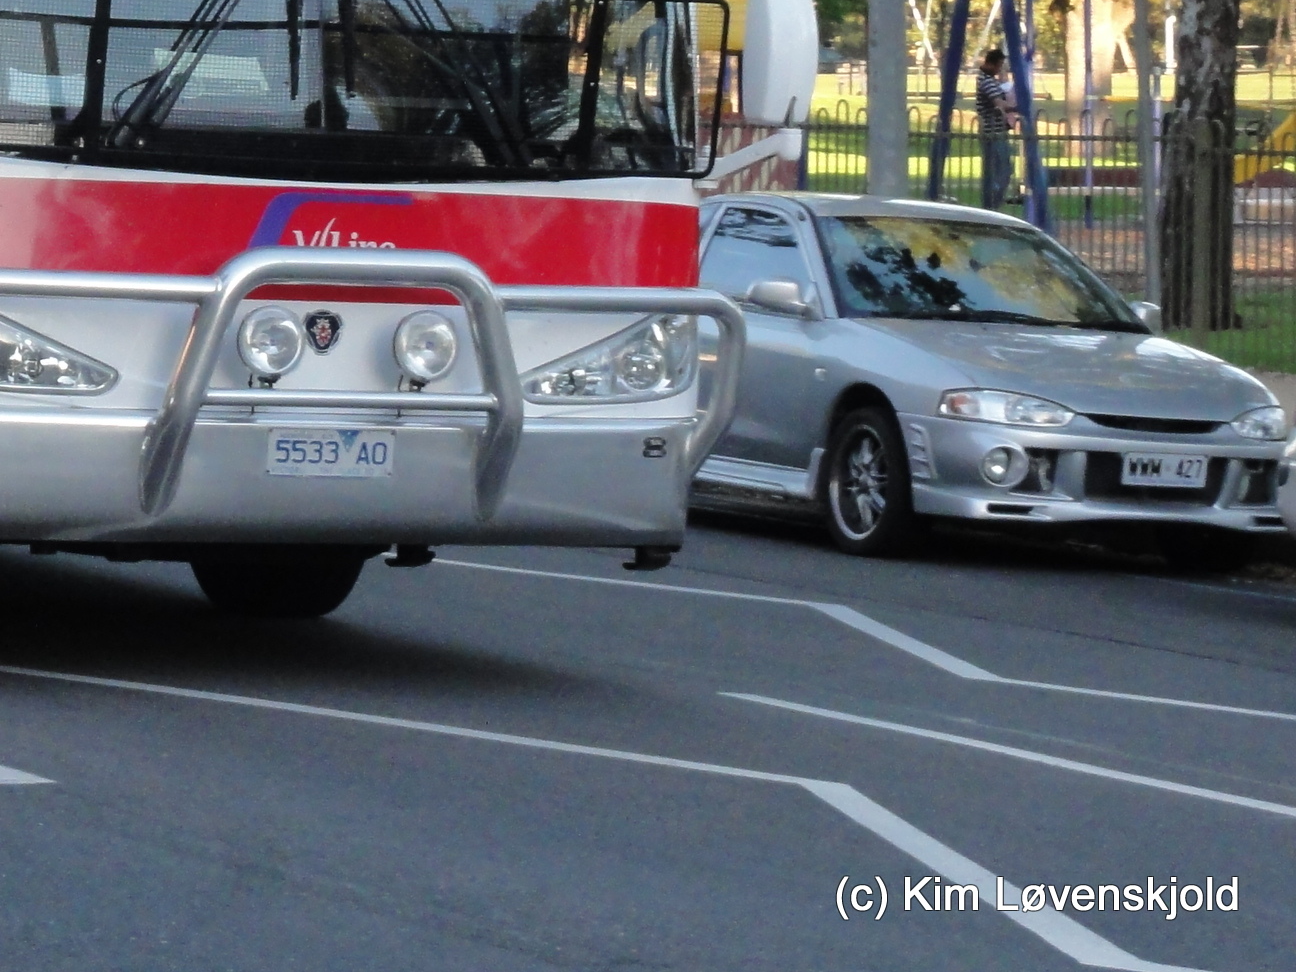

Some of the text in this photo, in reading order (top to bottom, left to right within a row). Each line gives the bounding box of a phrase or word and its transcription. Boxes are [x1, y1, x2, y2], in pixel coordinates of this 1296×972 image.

[275, 439, 388, 465] 5533 AO
[1176, 458, 1203, 478] 427
